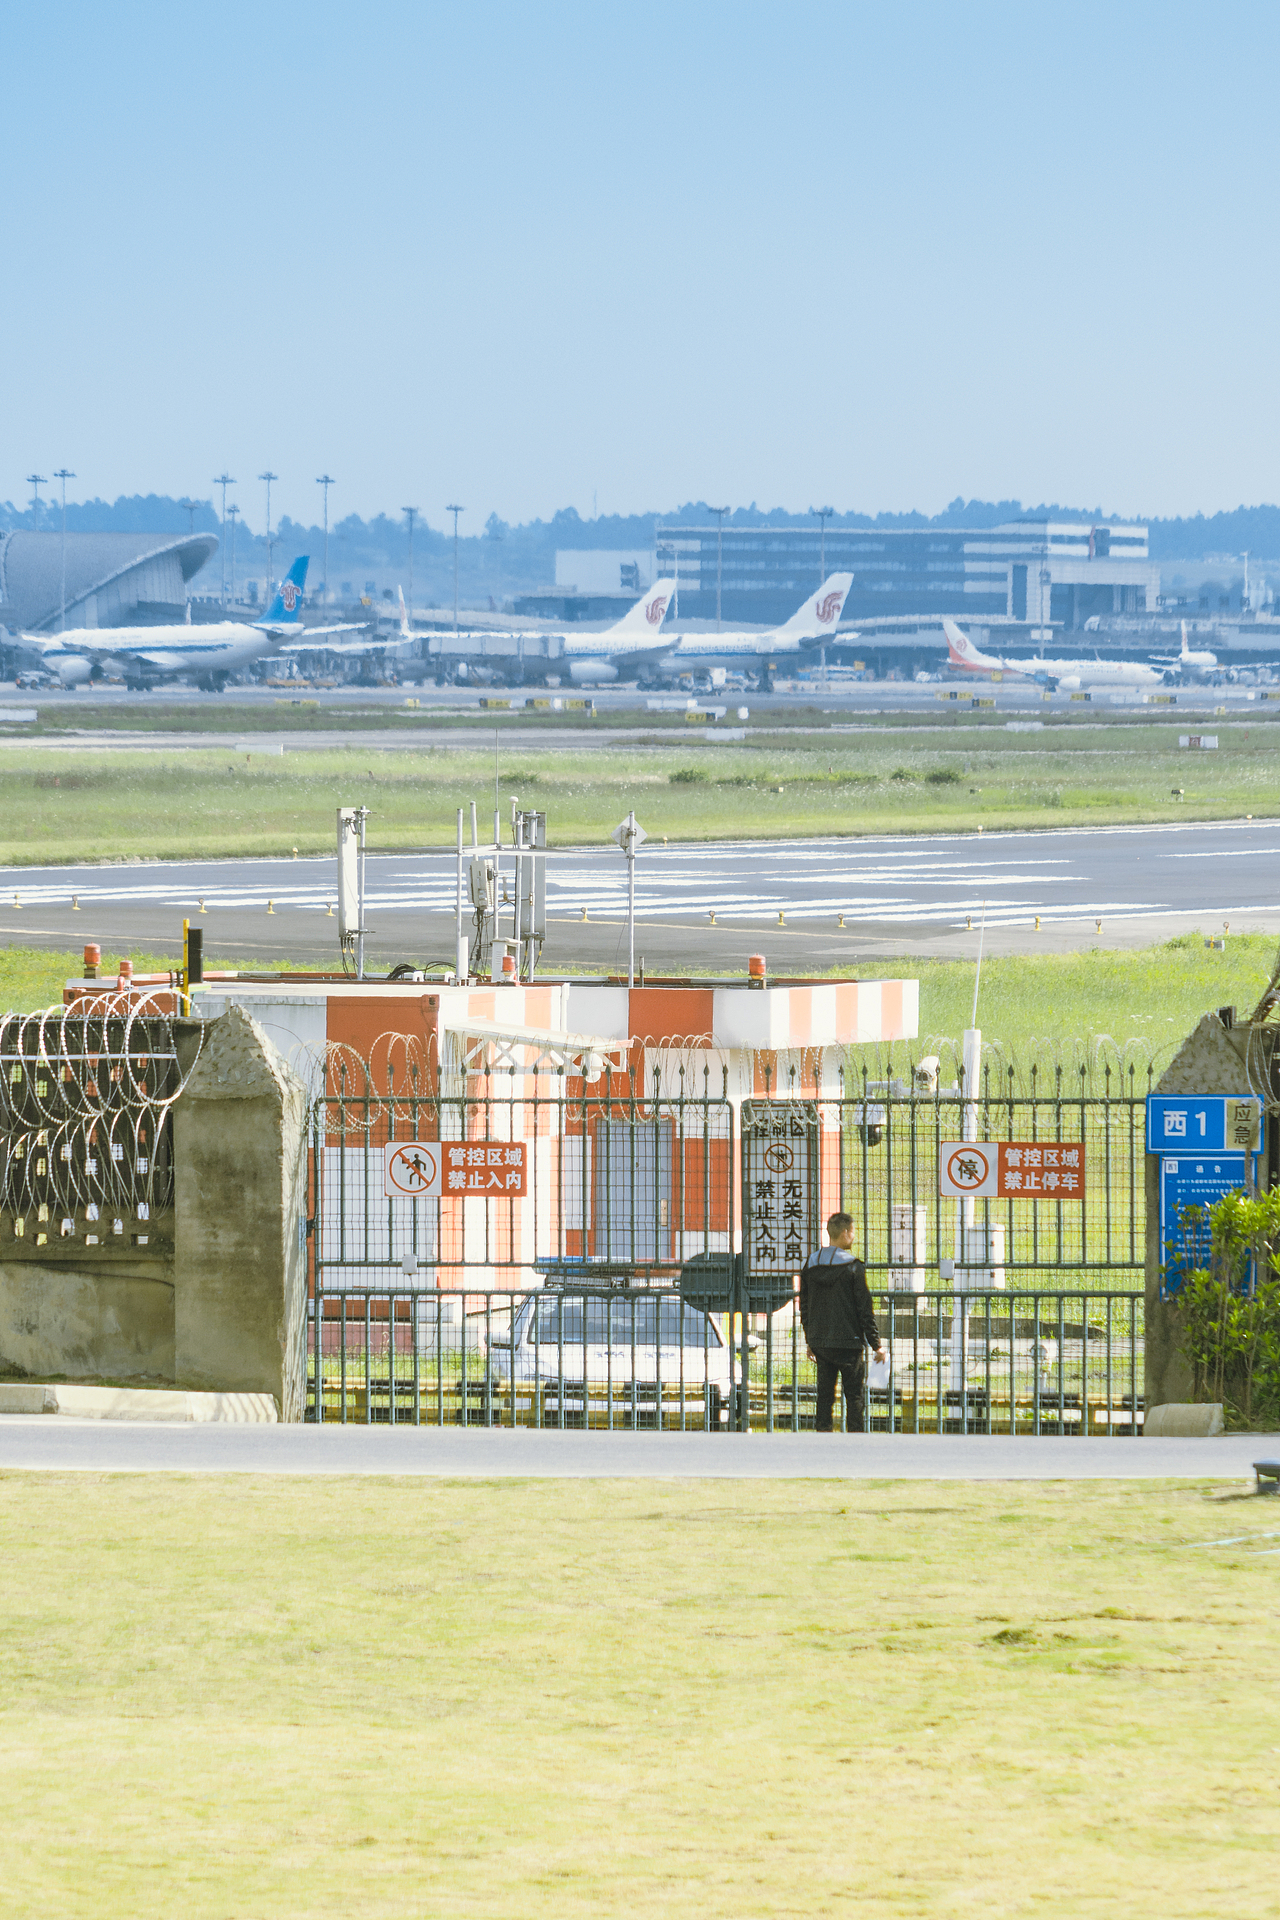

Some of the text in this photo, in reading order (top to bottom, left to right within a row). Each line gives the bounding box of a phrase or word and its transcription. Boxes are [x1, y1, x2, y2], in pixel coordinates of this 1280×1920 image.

[1234, 1104, 1252, 1144] 应急
[448, 1147, 523, 1167] 管控区域
[1004, 1148, 1079, 1168] 管控区域
[448, 1171, 522, 1190] 禁止入内
[1004, 1171, 1079, 1191] 禁止停车
[756, 1180, 776, 1262] 禁止入内
[782, 1180, 803, 1262] 无关人员
